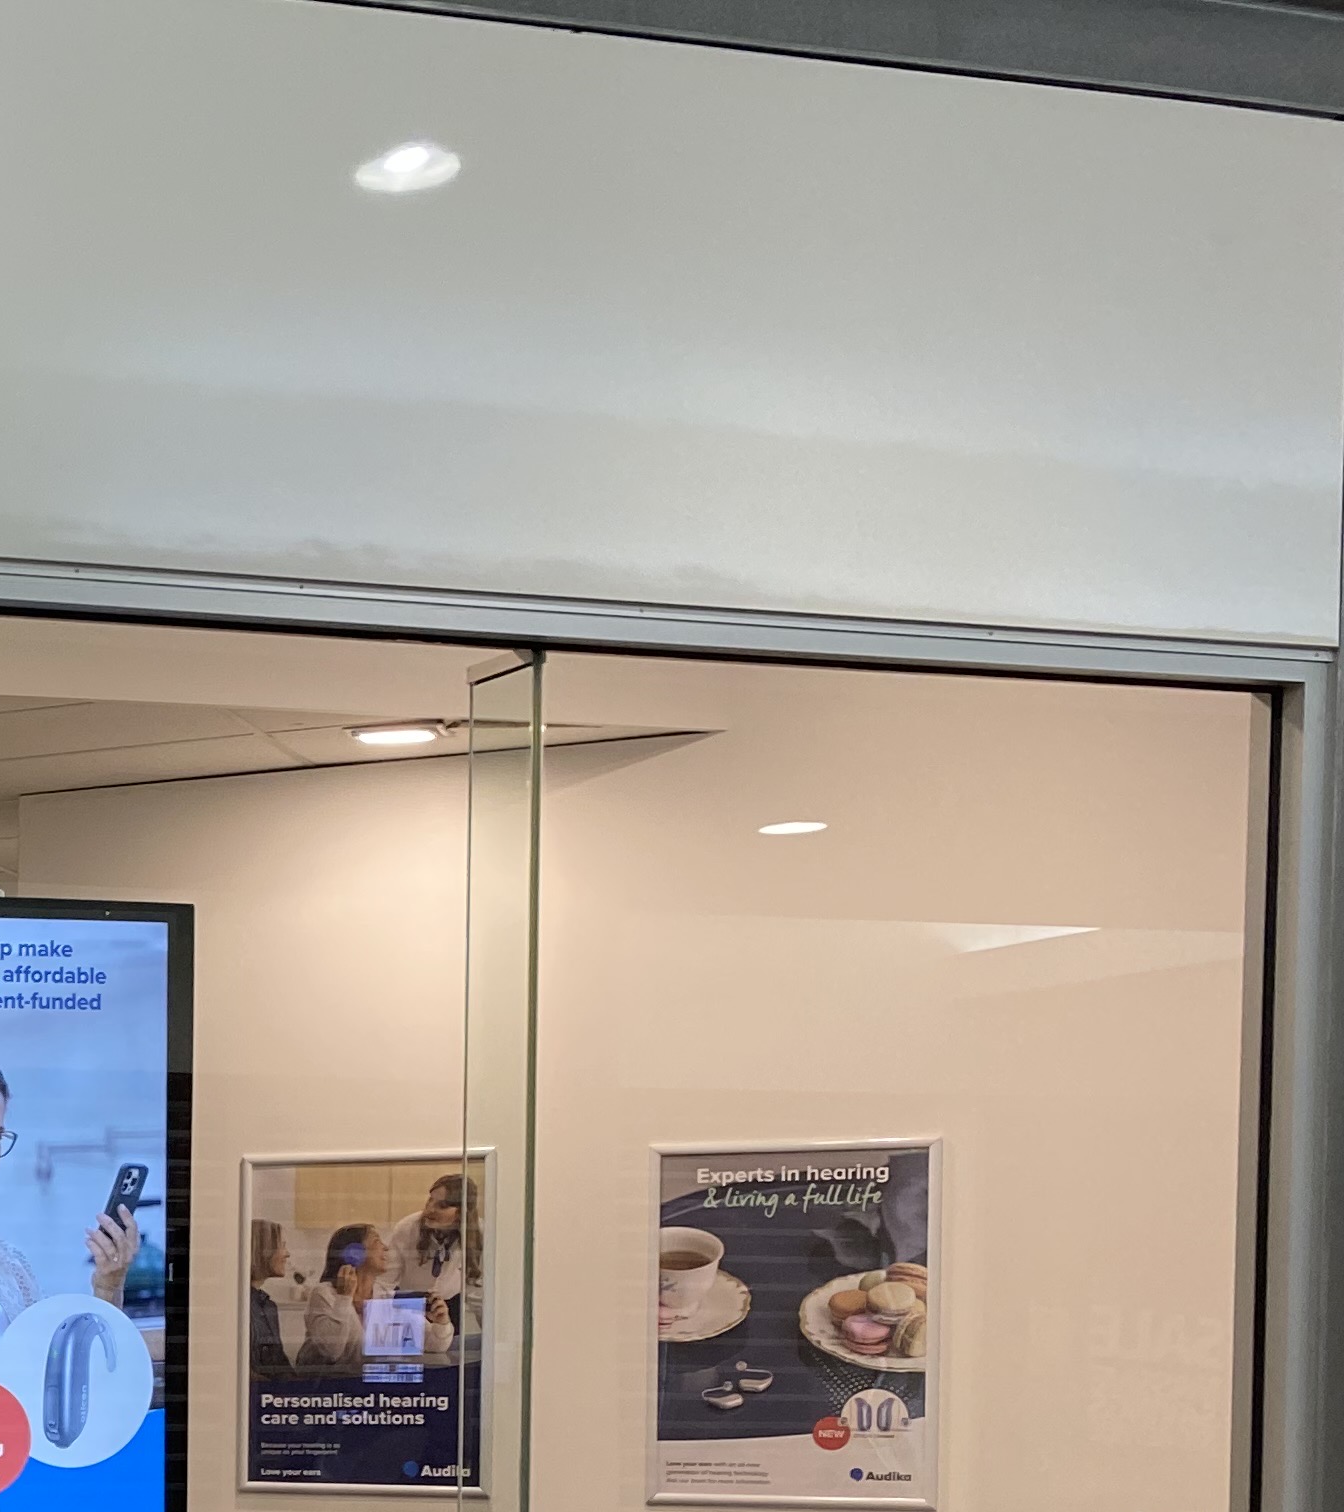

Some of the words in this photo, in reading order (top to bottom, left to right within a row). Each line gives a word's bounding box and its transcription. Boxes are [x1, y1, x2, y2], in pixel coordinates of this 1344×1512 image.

[18, 940, 73, 958] make
[3, 966, 107, 985] affordable
[696, 1166, 774, 1186] Experts
[781, 1165, 800, 1181] in
[806, 1164, 890, 1183] hearing
[703, 1188, 720, 1208] &
[724, 1184, 778, 1218] living
[785, 1193, 798, 1206] a
[803, 1184, 843, 1213] full
[846, 1181, 883, 1211] life
[260, 1393, 375, 1409] Personalised
[379, 1393, 449, 1411] hearing
[260, 1413, 299, 1425] care
[303, 1410, 337, 1425] and
[341, 1410, 425, 1426] solutions
[818, 1429, 845, 1438] NEW
[421, 1464, 471, 1477] Audia
[865, 1471, 912, 1481] Audika
